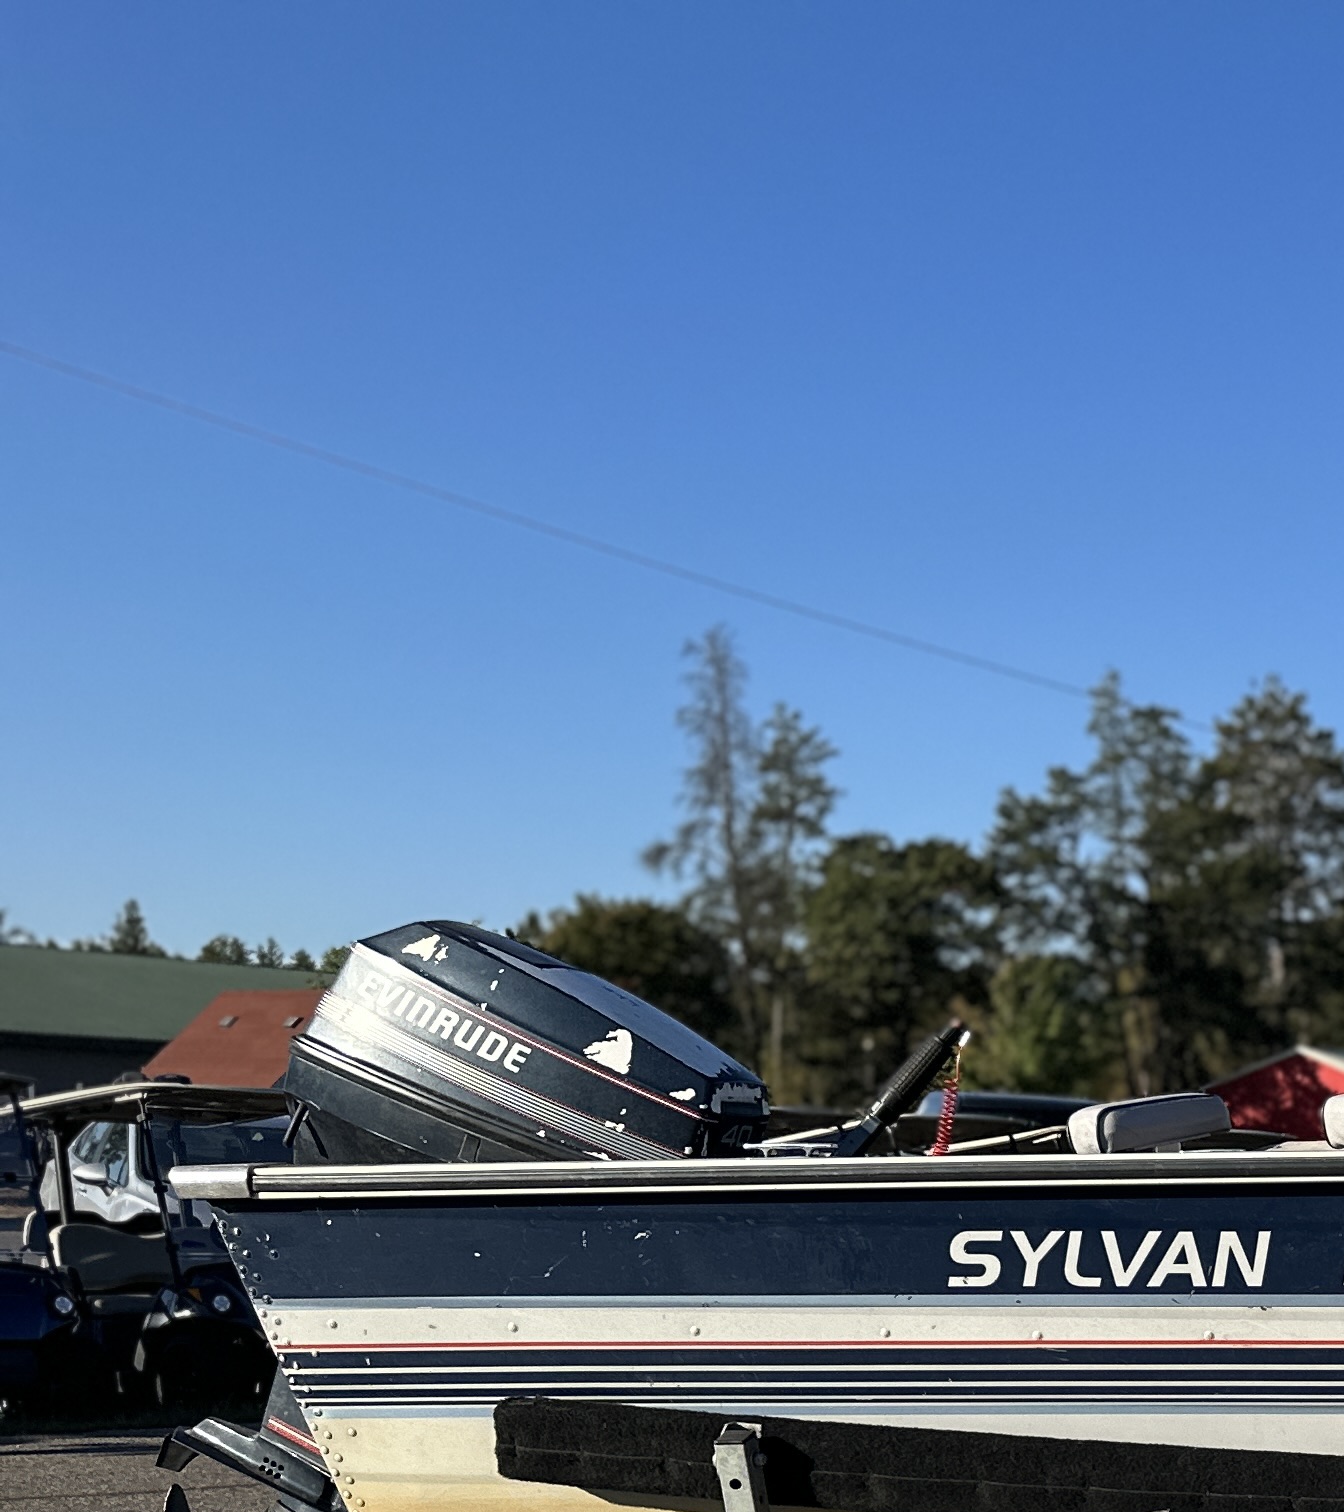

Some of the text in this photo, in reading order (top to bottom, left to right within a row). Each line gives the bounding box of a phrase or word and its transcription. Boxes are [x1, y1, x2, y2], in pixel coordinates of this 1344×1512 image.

[357, 971, 532, 1074] EVINRUDE
[720, 1125, 753, 1147] 40
[947, 1230, 1271, 1288] SYLVAN
